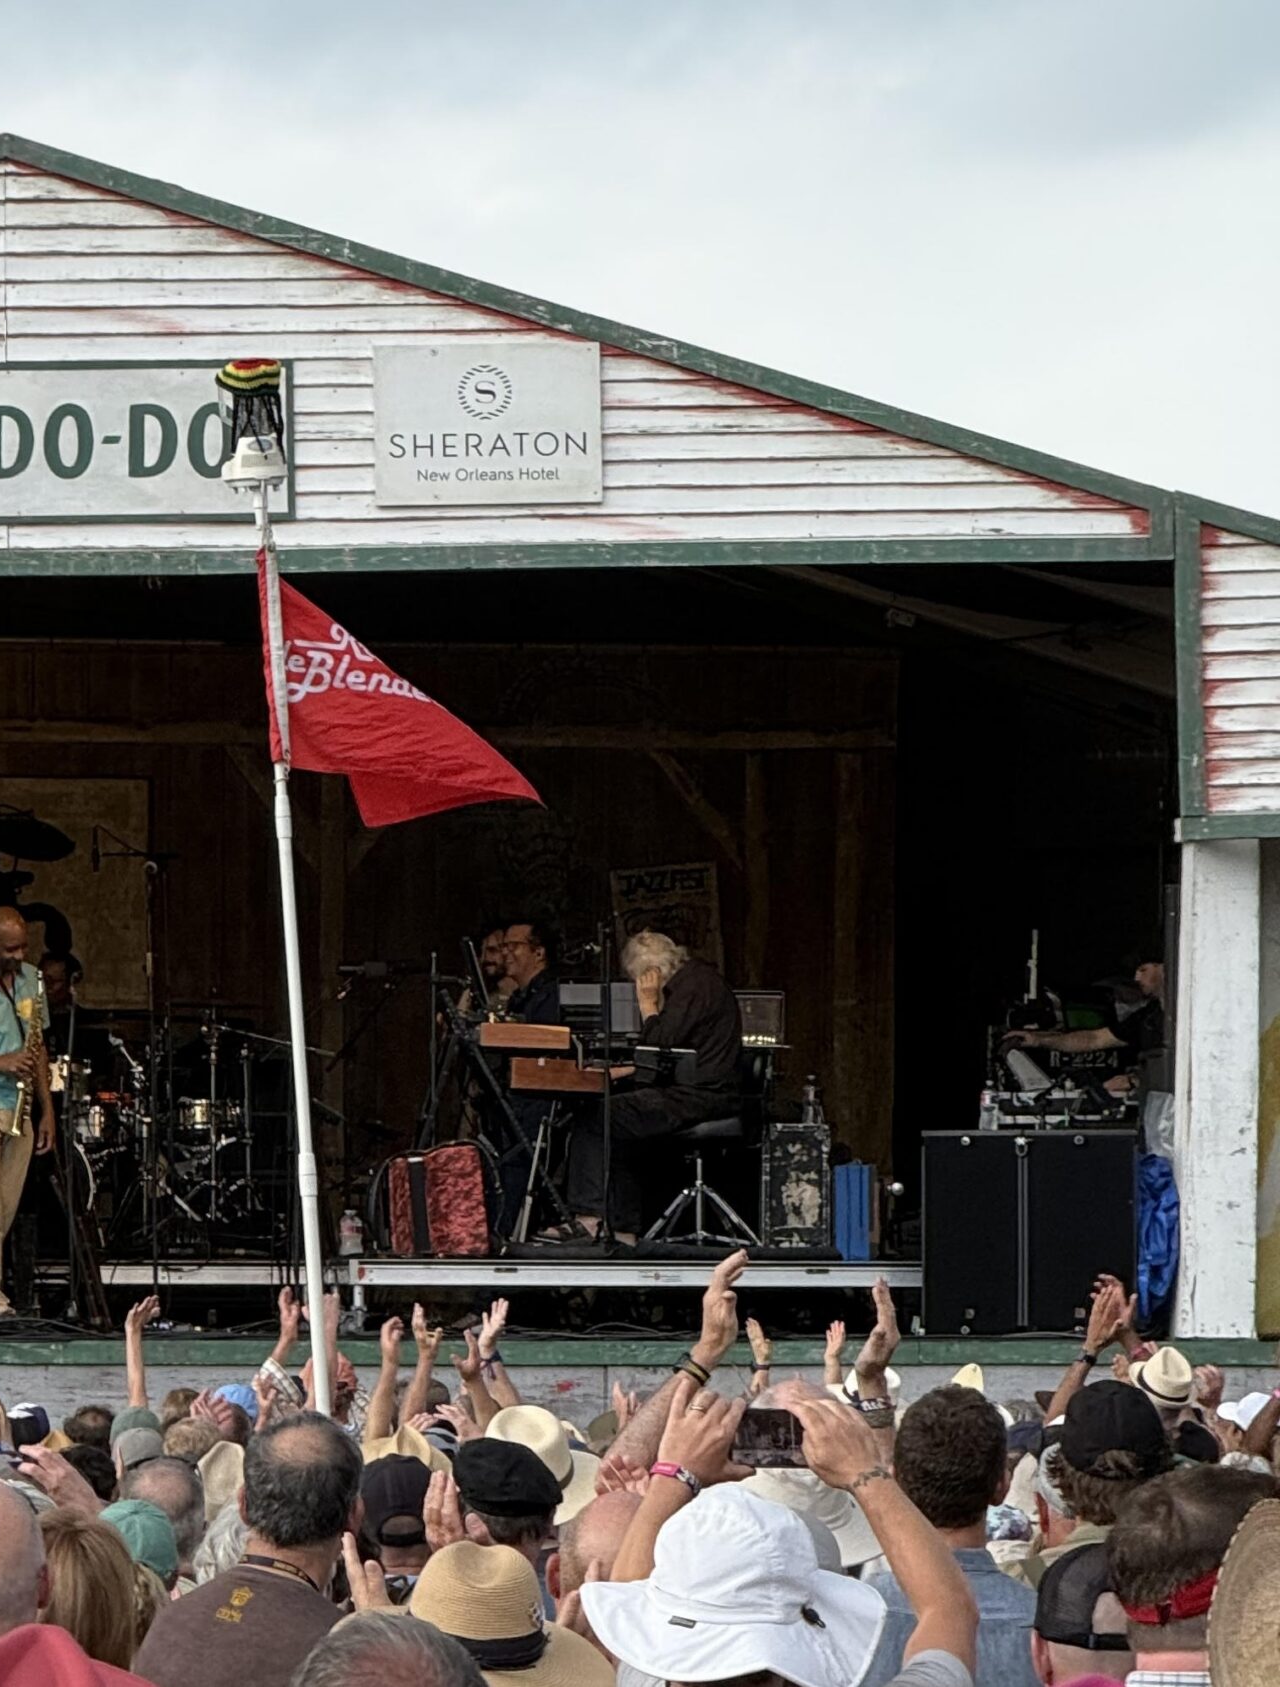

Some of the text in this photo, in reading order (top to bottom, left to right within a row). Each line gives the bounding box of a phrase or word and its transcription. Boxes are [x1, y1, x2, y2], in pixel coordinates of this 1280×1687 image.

[389, 432, 587, 459] SHERATON
[417, 466, 560, 482] New Orleans Hotel
